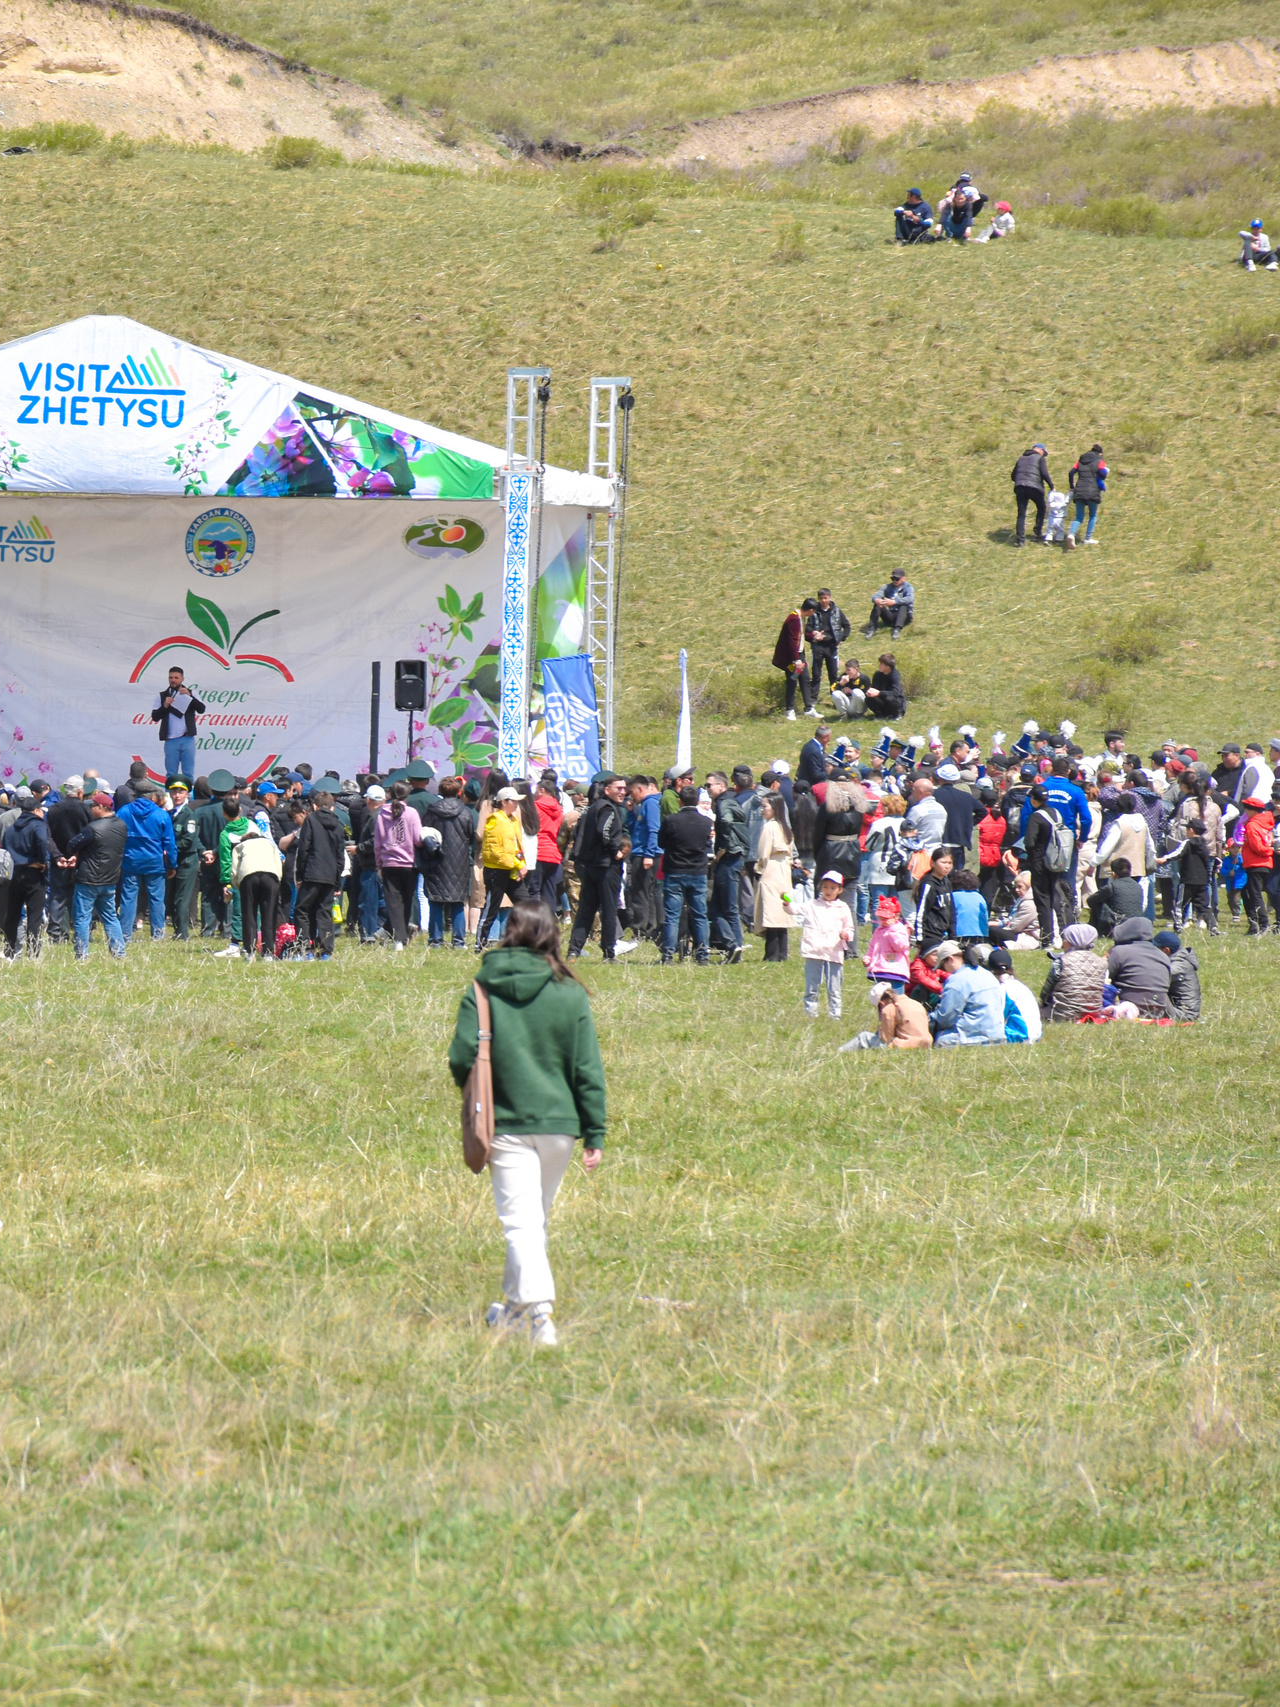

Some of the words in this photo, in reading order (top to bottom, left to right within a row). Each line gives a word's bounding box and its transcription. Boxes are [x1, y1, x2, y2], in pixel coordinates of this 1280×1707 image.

[18, 362, 110, 392] VISIT
[17, 395, 185, 428] ZHETYSU
[195, 732, 256, 757] лденуі
